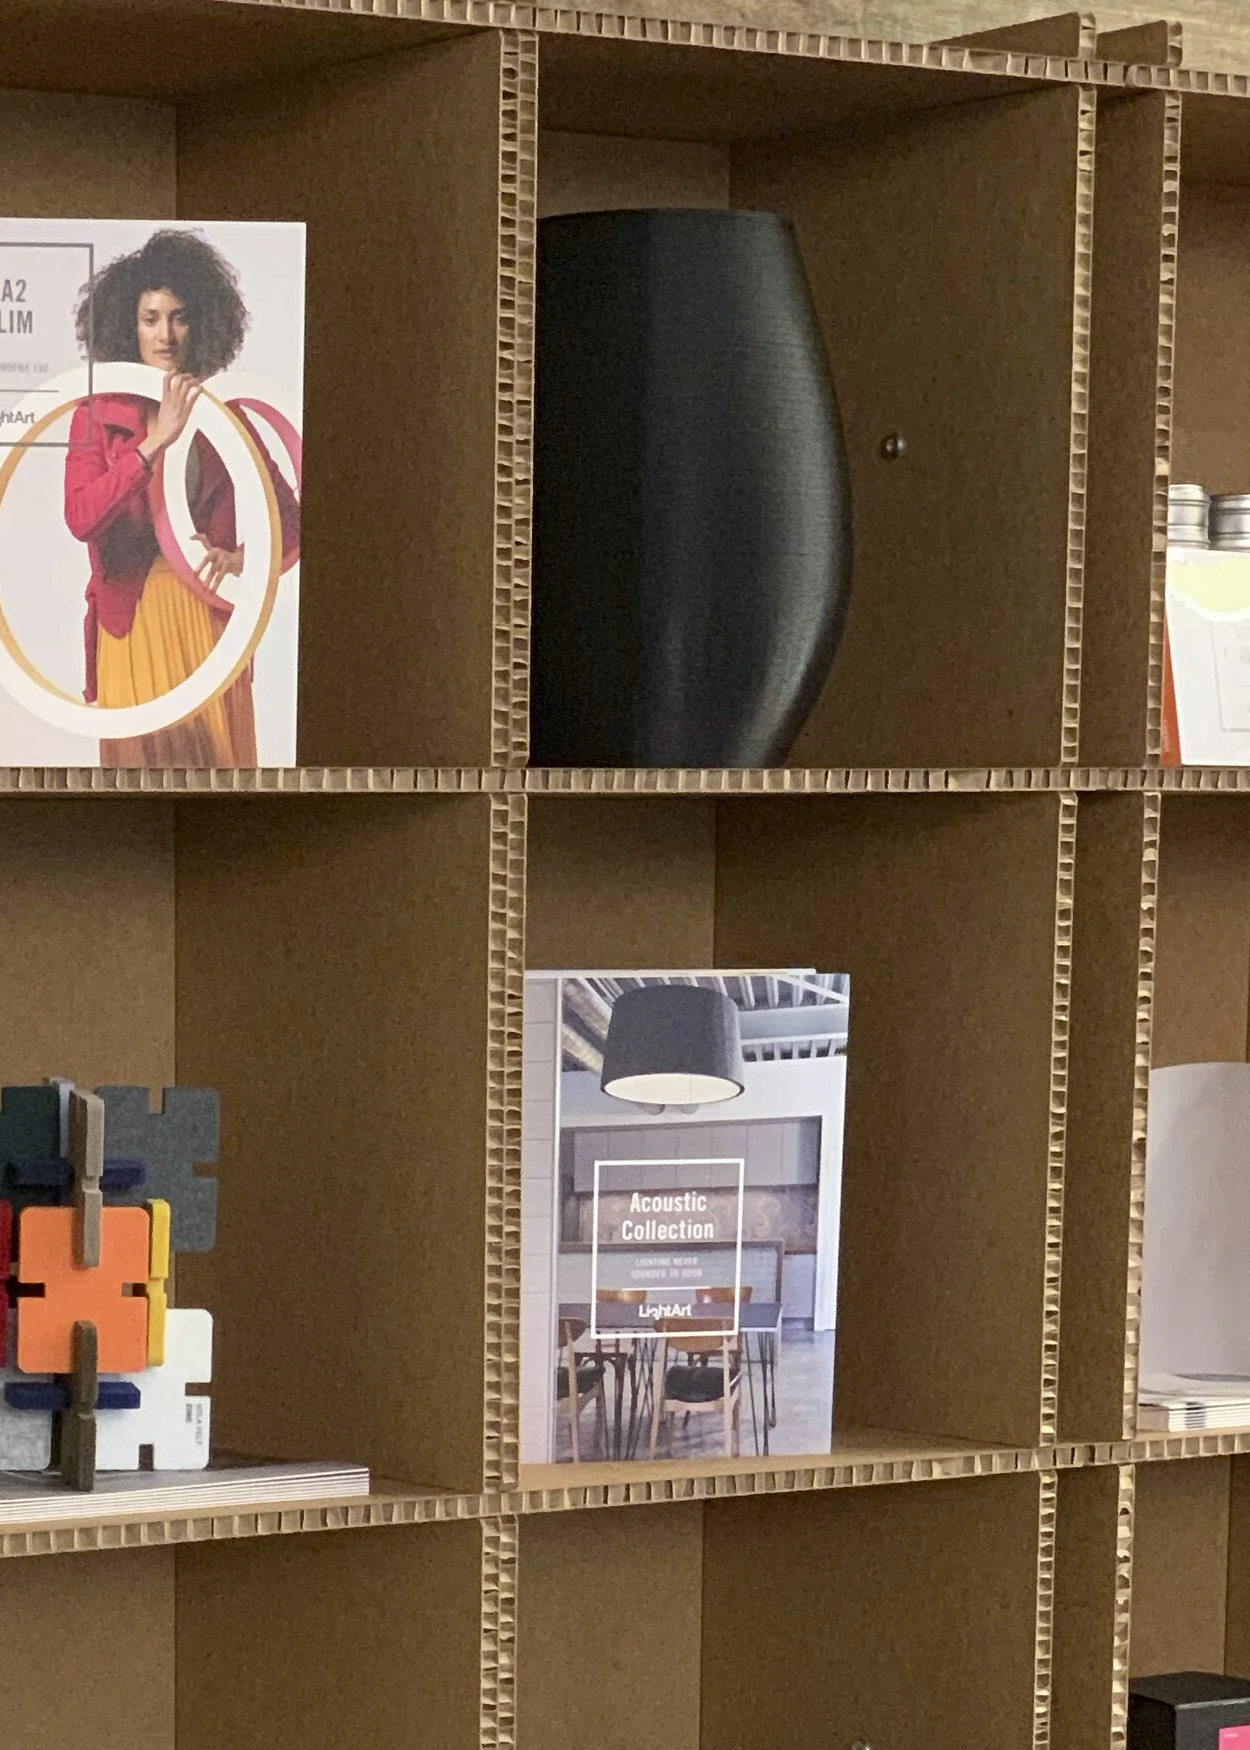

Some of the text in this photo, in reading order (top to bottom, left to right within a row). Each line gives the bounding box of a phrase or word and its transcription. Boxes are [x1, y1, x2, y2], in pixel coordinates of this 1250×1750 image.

[630, 1191, 707, 1212] Acoustic
[622, 1219, 714, 1240] Collection
[638, 1303, 693, 1321] LightArt
